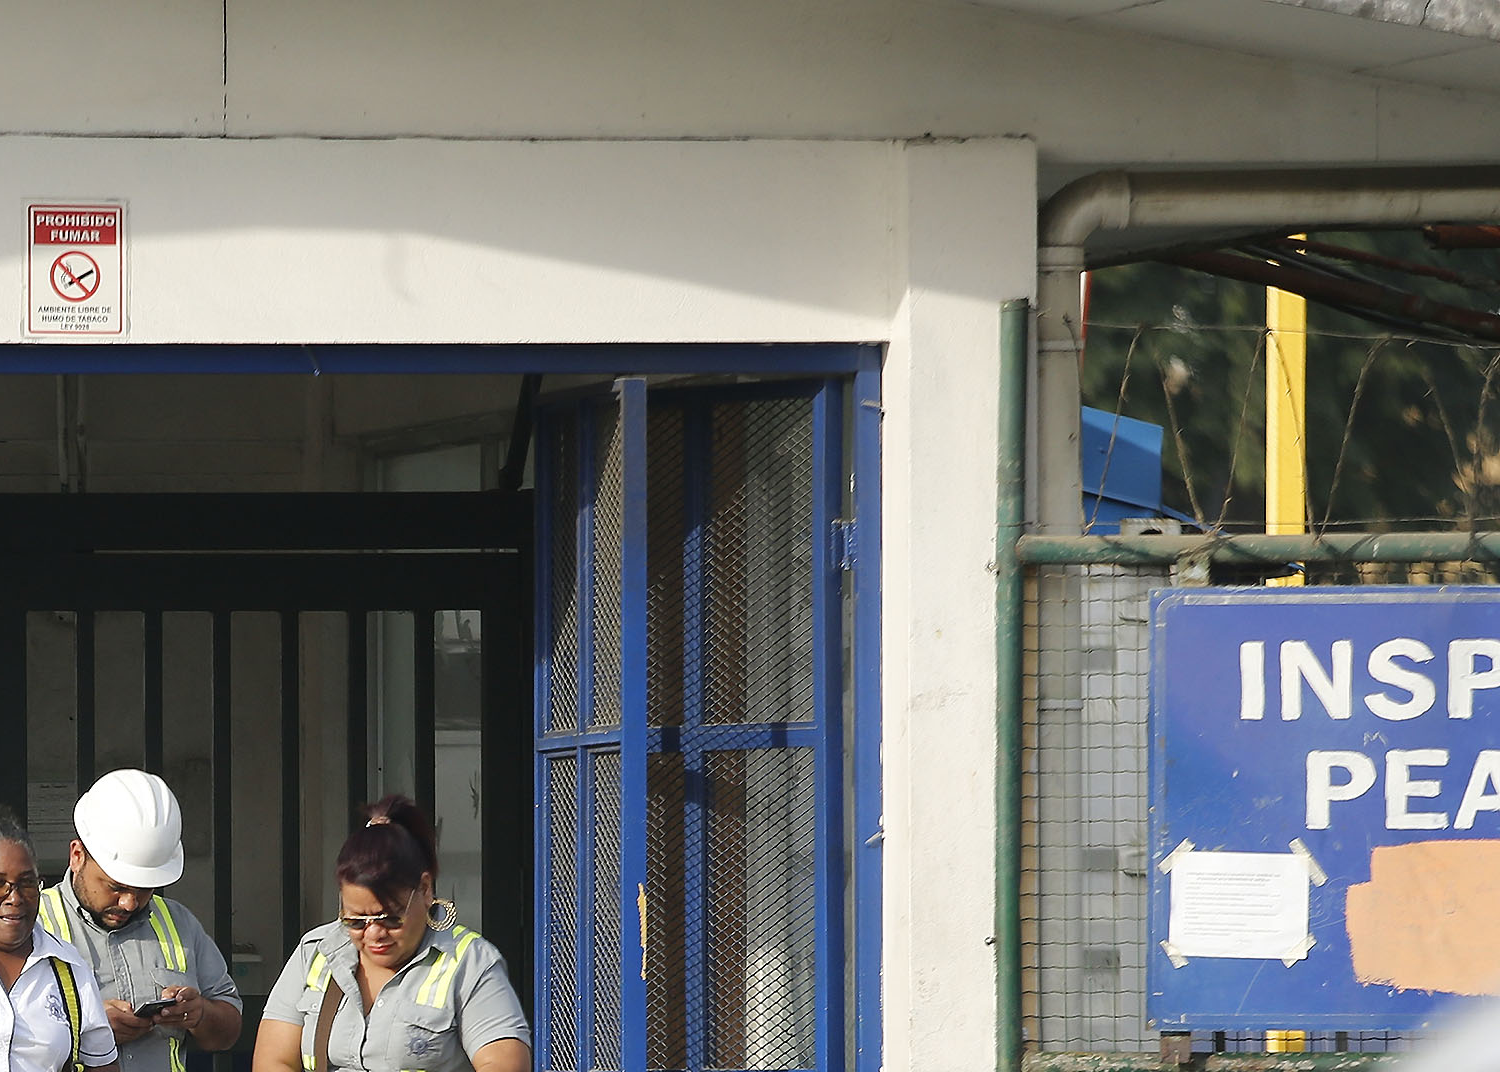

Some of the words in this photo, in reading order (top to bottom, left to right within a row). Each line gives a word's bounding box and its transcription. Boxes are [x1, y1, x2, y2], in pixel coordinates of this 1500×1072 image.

[36, 214, 116, 228] PROHIBIDO
[51, 229, 101, 243] FUMAR
[38, 306, 75, 314] AMBIENTE
[77, 306, 100, 314] LIBRE
[41, 315, 64, 323] HUMO
[78, 315, 108, 323] TABACO
[60, 323, 73, 331] LEY
[1239, 638, 1500, 722] INSP
